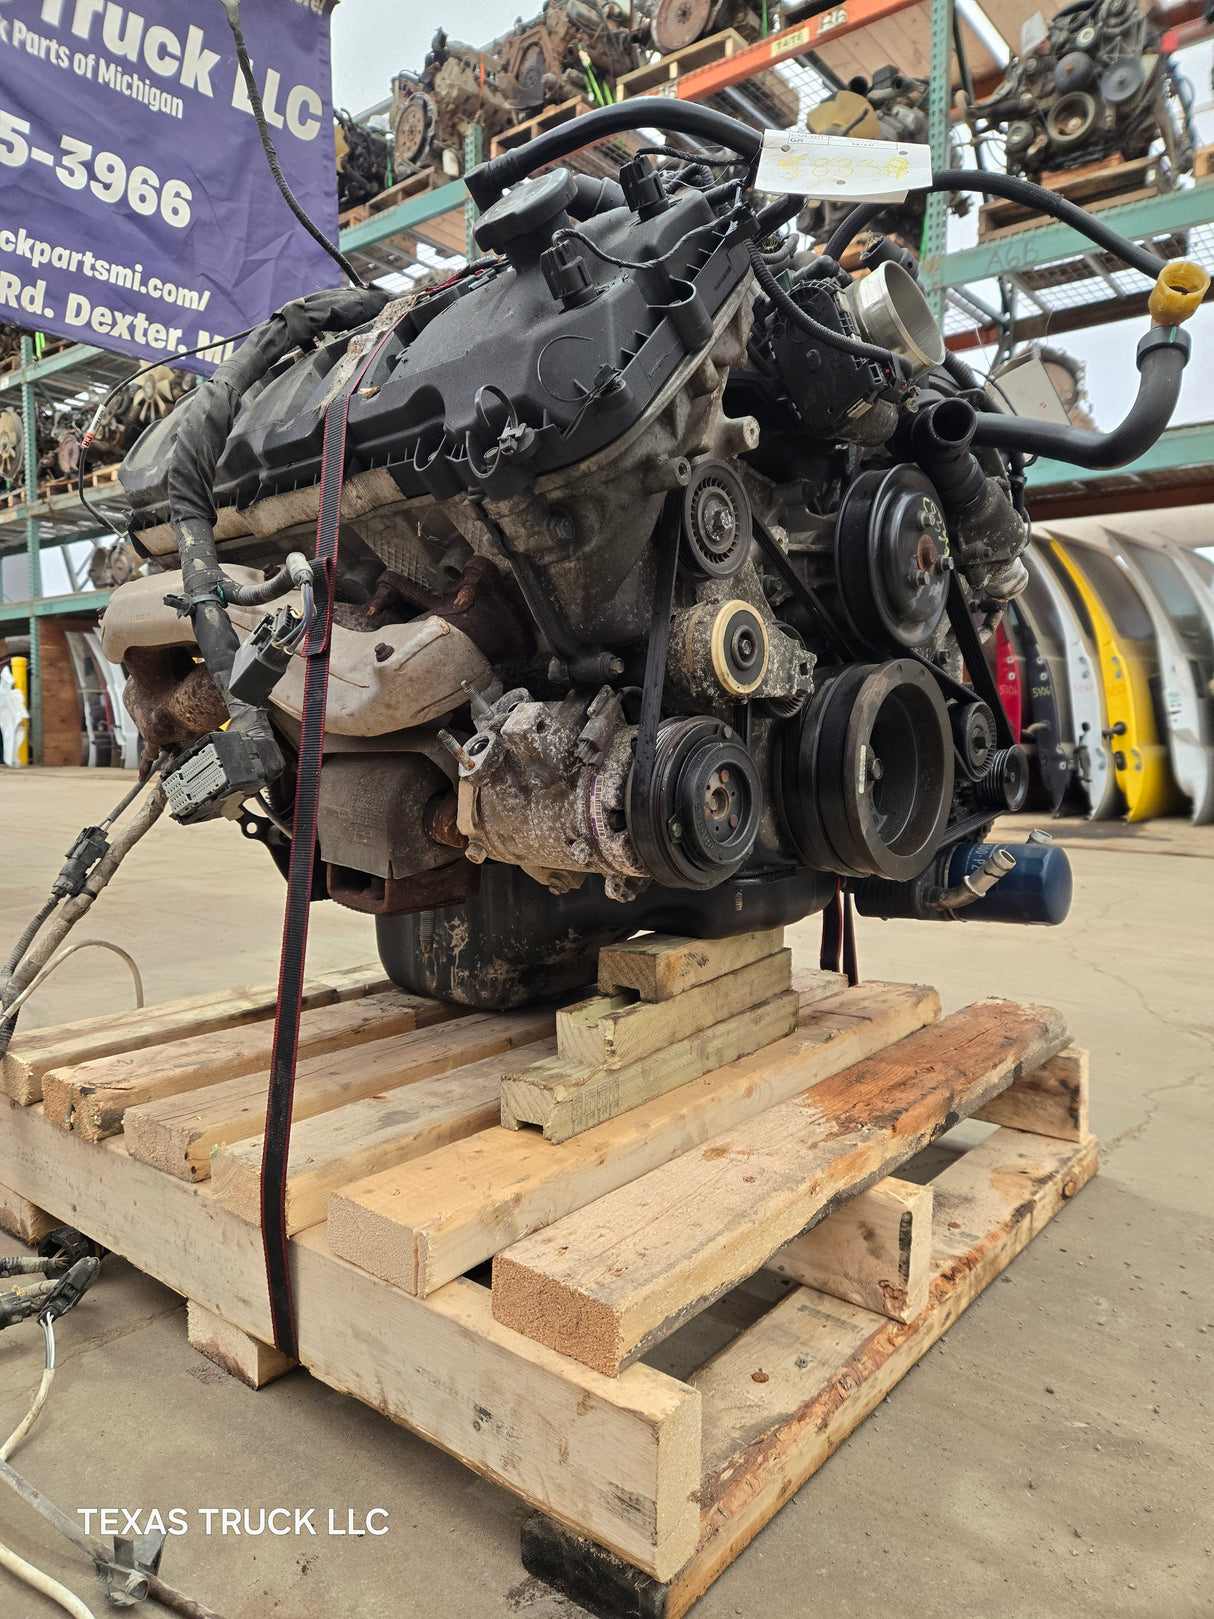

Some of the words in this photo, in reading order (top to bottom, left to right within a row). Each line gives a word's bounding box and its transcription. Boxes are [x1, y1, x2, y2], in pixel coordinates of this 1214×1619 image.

[12, 18, 70, 68] Parts
[73, 52, 97, 77] of
[97, 57, 184, 119] Michigan
[231, 58, 323, 141] LLC
[0, 109, 193, 228] 5-3966
[0, 228, 211, 312] ckpartsmi.com/
[0, 271, 55, 319] Rd.
[196, 330, 235, 364] MI
